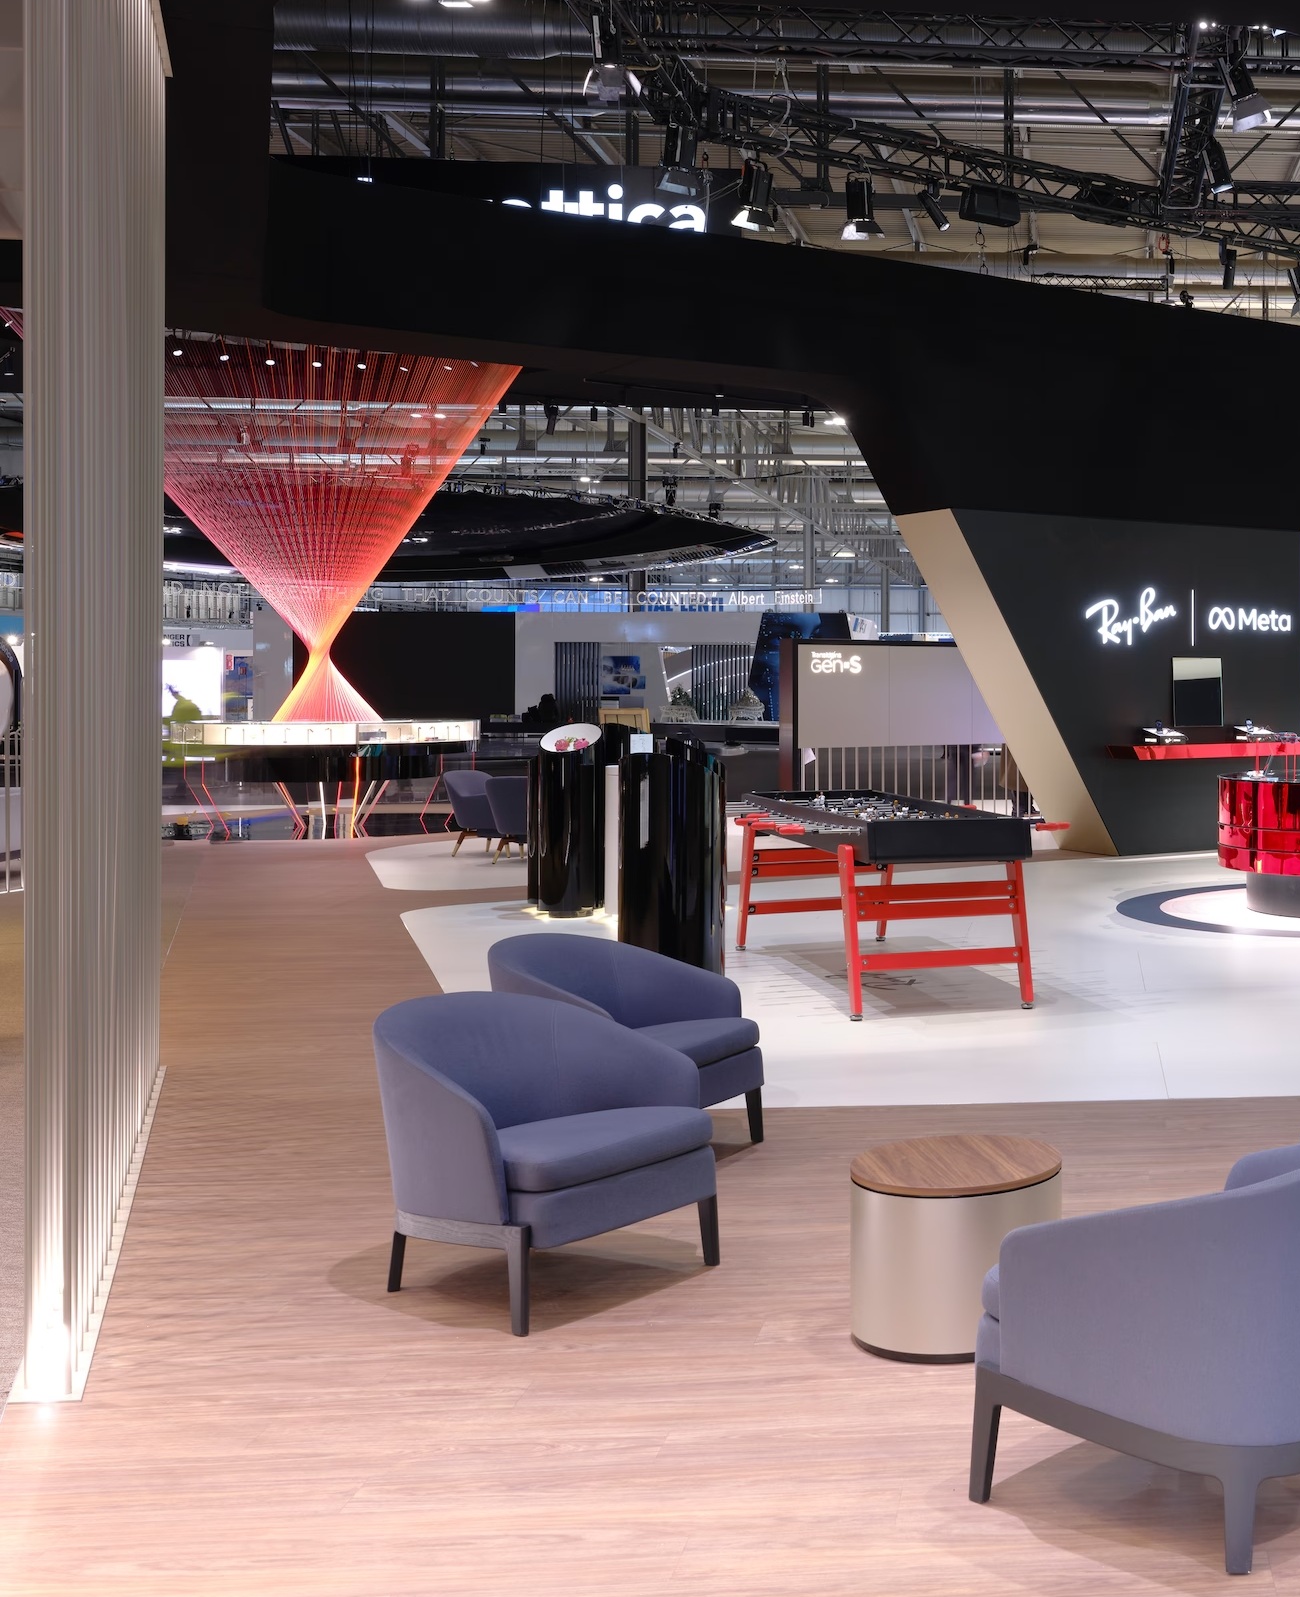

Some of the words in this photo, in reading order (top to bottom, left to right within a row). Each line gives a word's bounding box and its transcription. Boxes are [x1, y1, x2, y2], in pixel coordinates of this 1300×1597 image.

[401, 587, 449, 602] THAT
[553, 589, 588, 604] CAN
[603, 591, 622, 605] BE
[728, 590, 765, 605] Albert
[774, 590, 814, 605] Einstein
[1238, 606, 1292, 632] Meta
